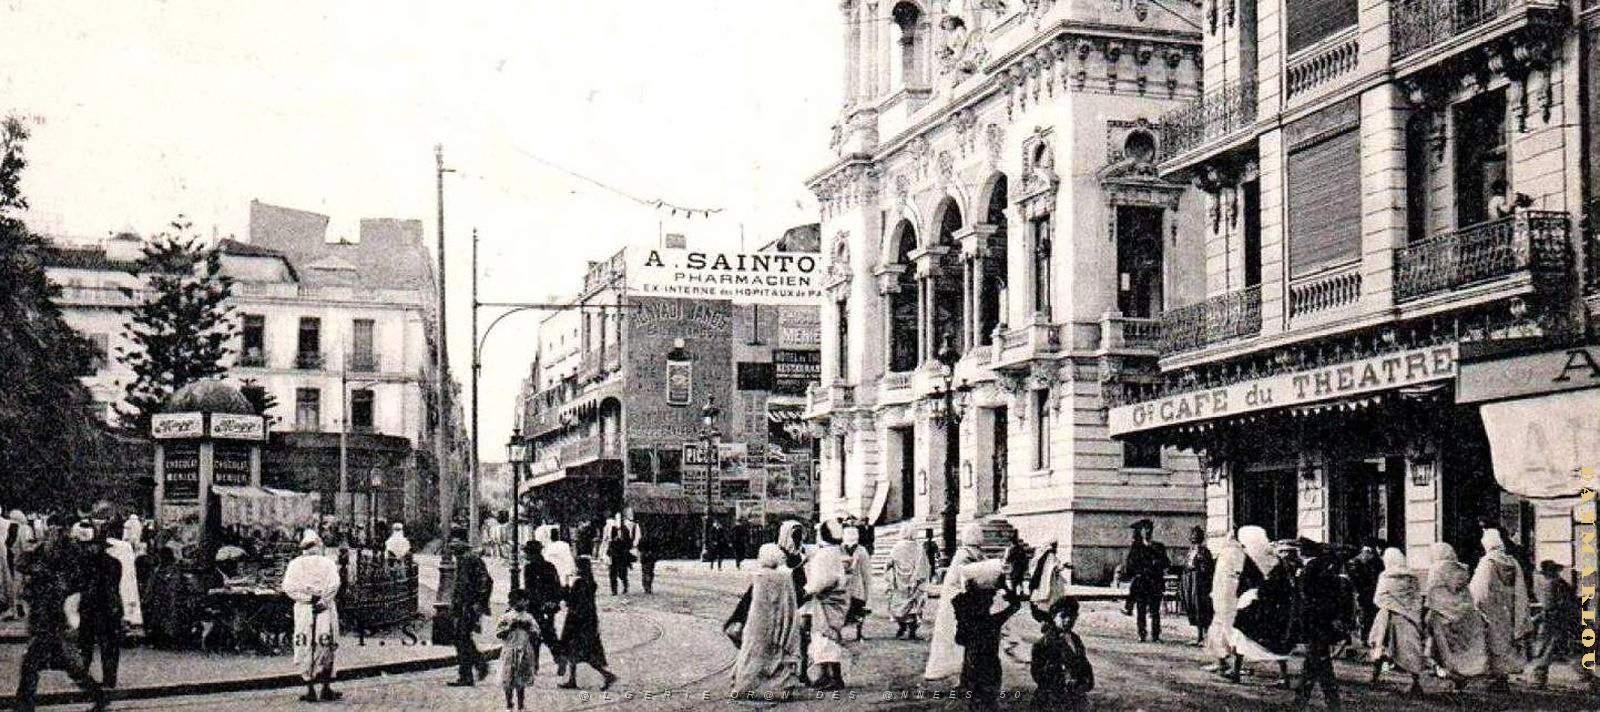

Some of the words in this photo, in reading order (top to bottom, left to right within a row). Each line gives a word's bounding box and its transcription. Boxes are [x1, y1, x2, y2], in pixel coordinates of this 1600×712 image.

[687, 252, 822, 273] SAINTO
[675, 272, 811, 286] PHARMACIEN
[643, 284, 658, 292] EX
[665, 286, 716, 295] INTERNE
[1160, 389, 1229, 422] CAFE
[1244, 384, 1273, 407] du
[1292, 348, 1454, 398] THEATRE
